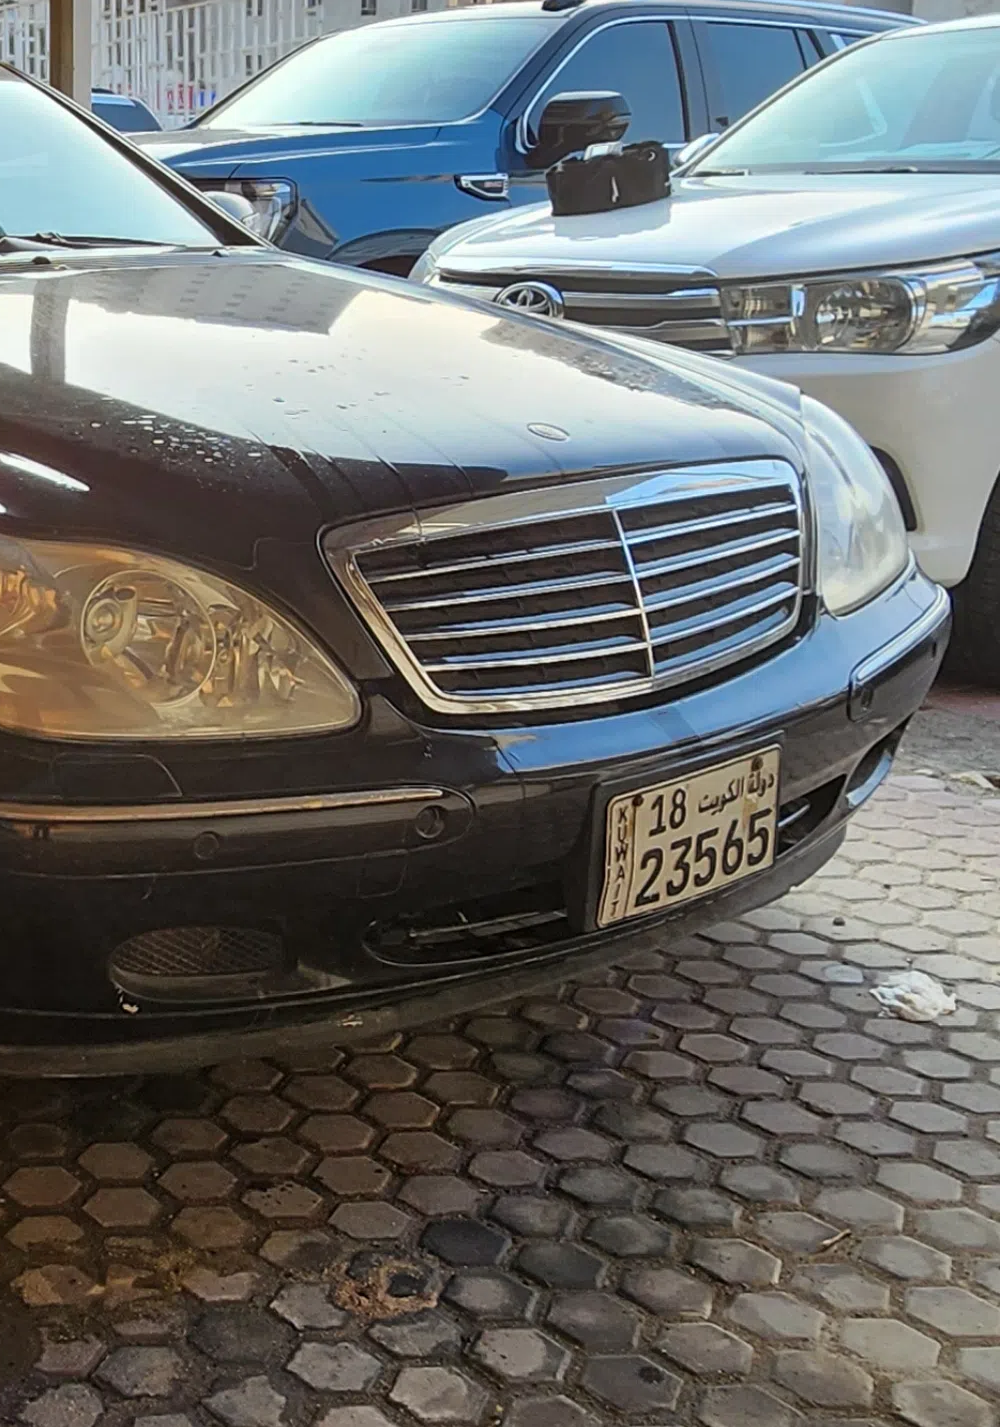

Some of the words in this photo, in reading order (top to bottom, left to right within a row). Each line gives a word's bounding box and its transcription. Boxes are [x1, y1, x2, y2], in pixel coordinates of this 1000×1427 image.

[698, 776, 745, 816] الكويت
[748, 770, 776, 798] دولة
[649, 787, 687, 837] 18
[610, 806, 630, 917] KUWAIT
[634, 808, 773, 908] 23565
